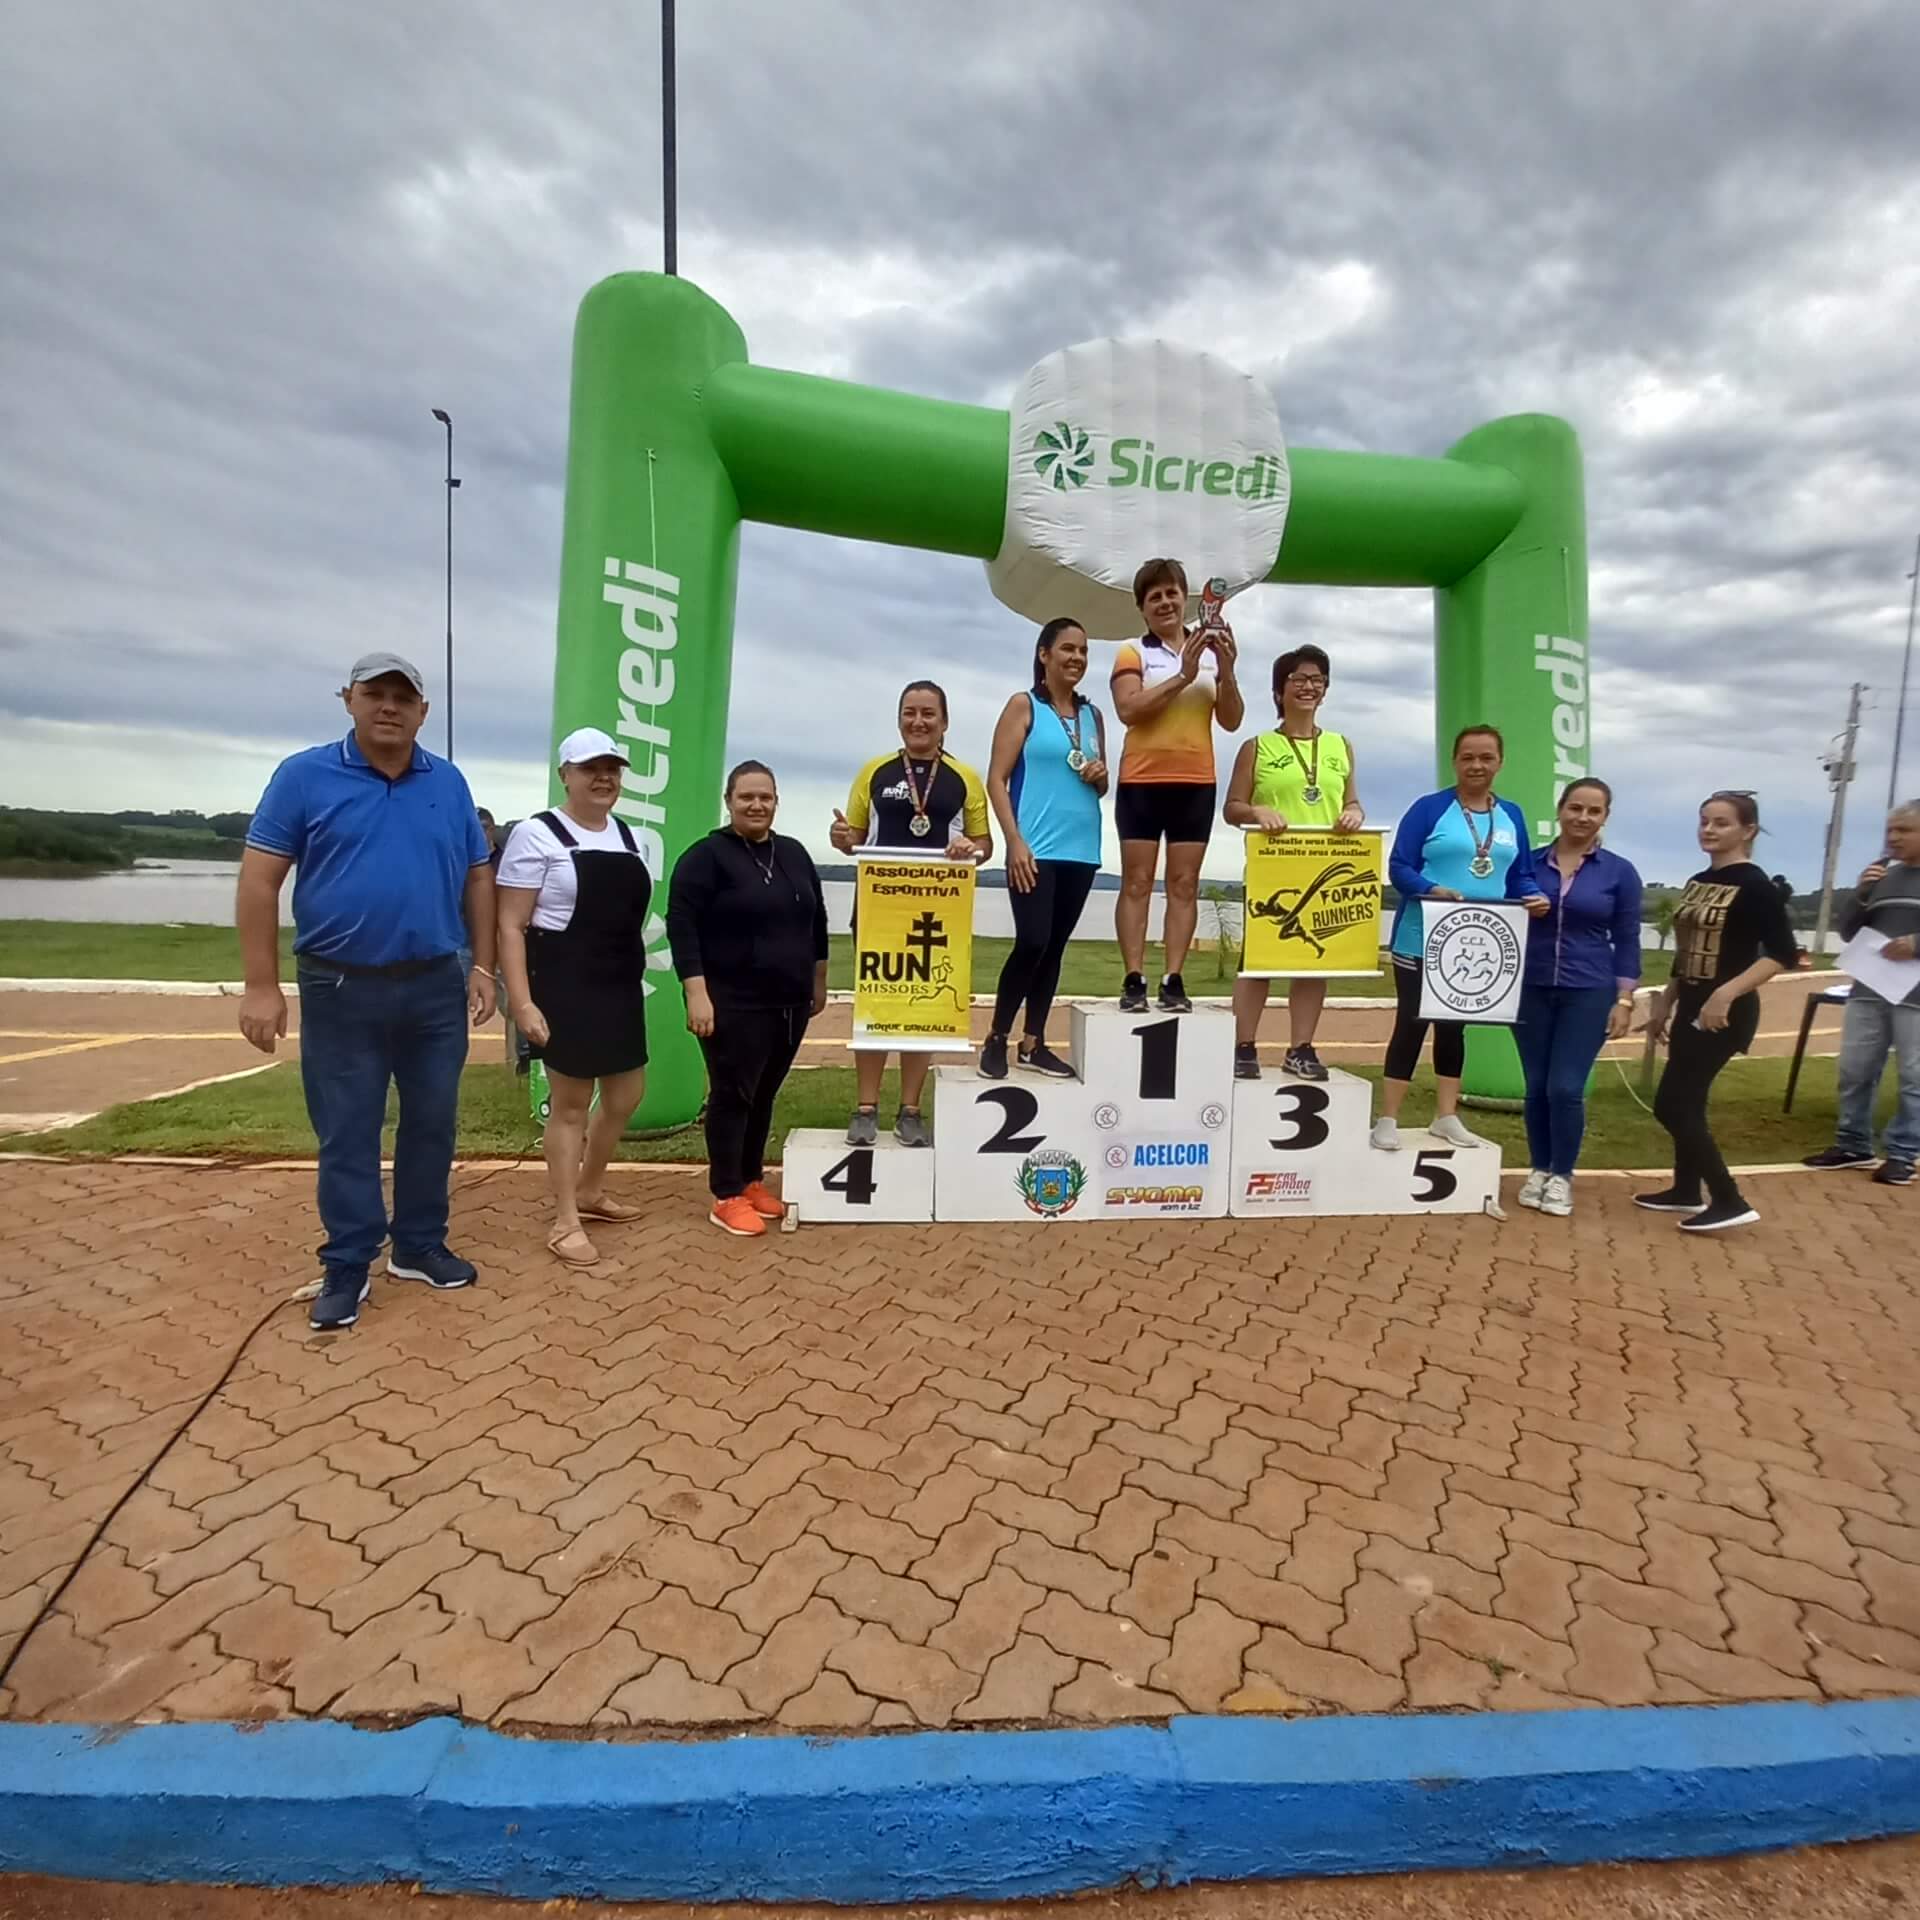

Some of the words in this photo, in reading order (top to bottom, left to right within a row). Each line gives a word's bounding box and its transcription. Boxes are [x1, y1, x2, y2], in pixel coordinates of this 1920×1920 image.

[1108, 438, 1279, 500] Sicredi
[1312, 902, 1374, 929] RUNNERS
[1320, 884, 1379, 906] FORMA
[860, 951, 931, 983] RUN
[1427, 938, 1442, 972] CLUBE
[1435, 923, 1453, 938] DE
[1451, 913, 1516, 960] CORREDORES
[1131, 1016, 1180, 1100] 1
[974, 1085, 1047, 1154] 2
[1268, 1084, 1330, 1151] 3
[820, 1149, 878, 1205] 4
[1133, 1143, 1209, 1167] ACELCOR
[1410, 1149, 1458, 1202] 5
